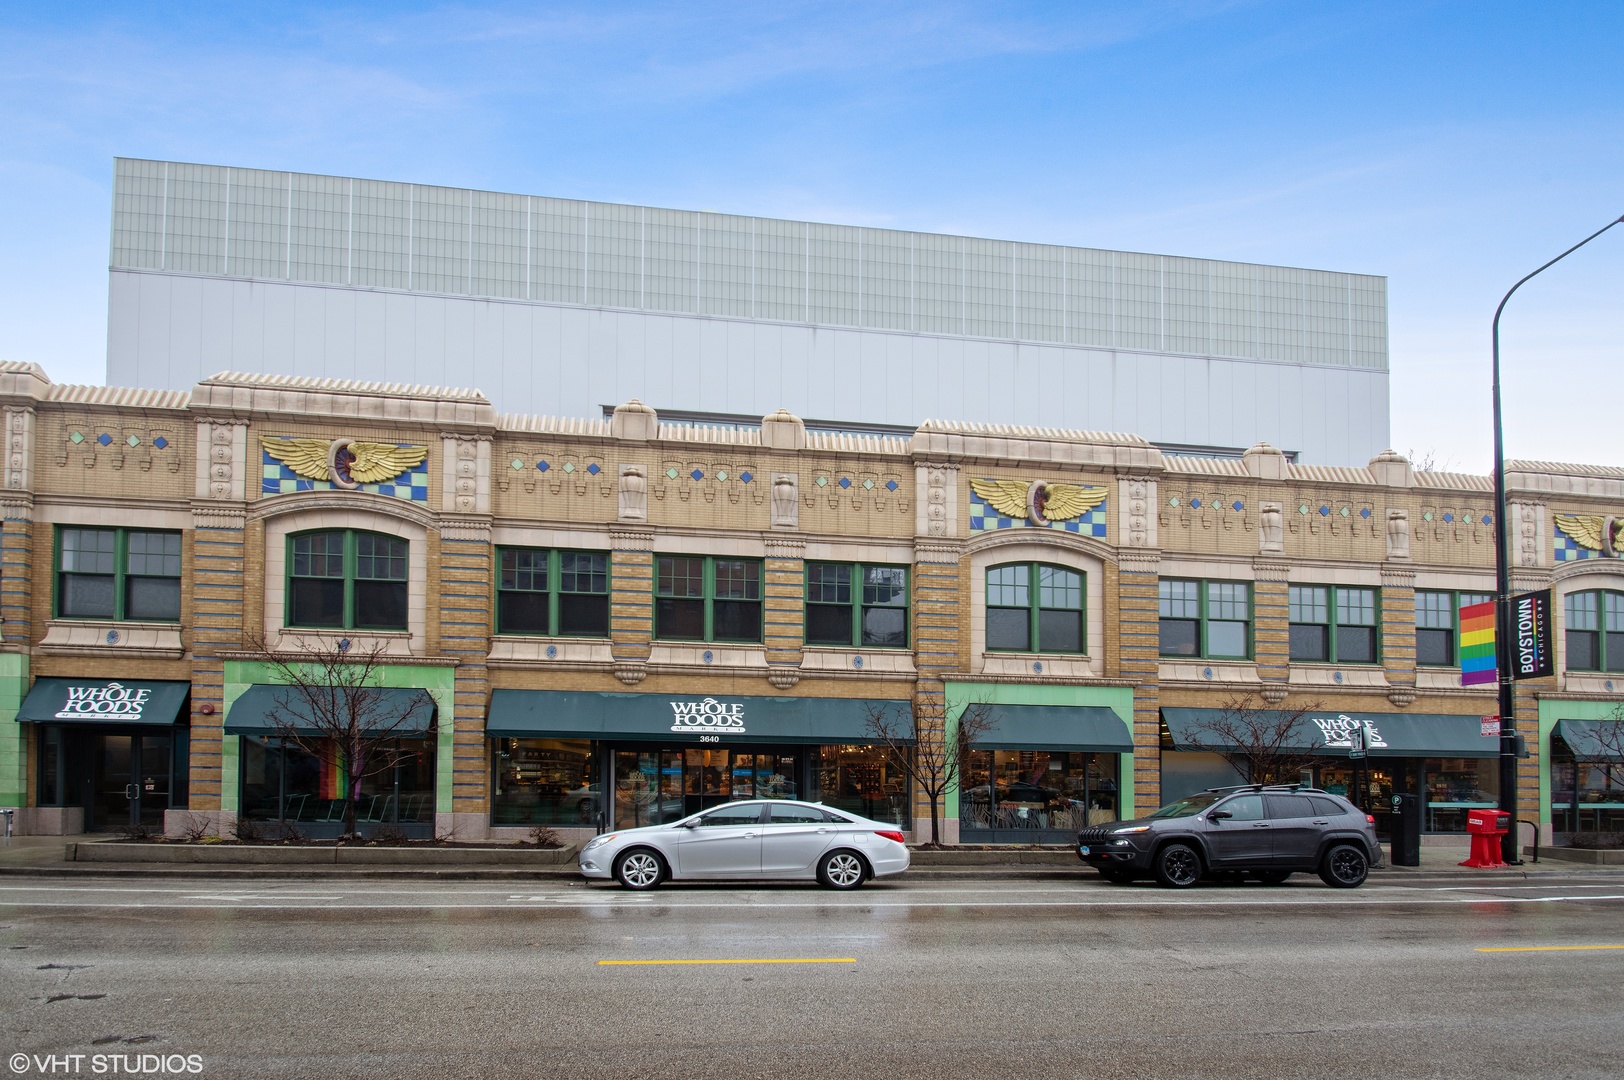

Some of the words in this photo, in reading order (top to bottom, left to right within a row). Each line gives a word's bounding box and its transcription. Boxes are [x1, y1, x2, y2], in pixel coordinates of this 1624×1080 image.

[1518, 598, 1534, 673] BOYSTOWN
[1537, 613, 1545, 654] CHICAGO
[67, 686, 152, 701] WHOLE
[61, 699, 144, 714] FOODS
[669, 701, 745, 715] WHOLE
[673, 713, 744, 727] FOODS
[699, 735, 720, 743] 3640
